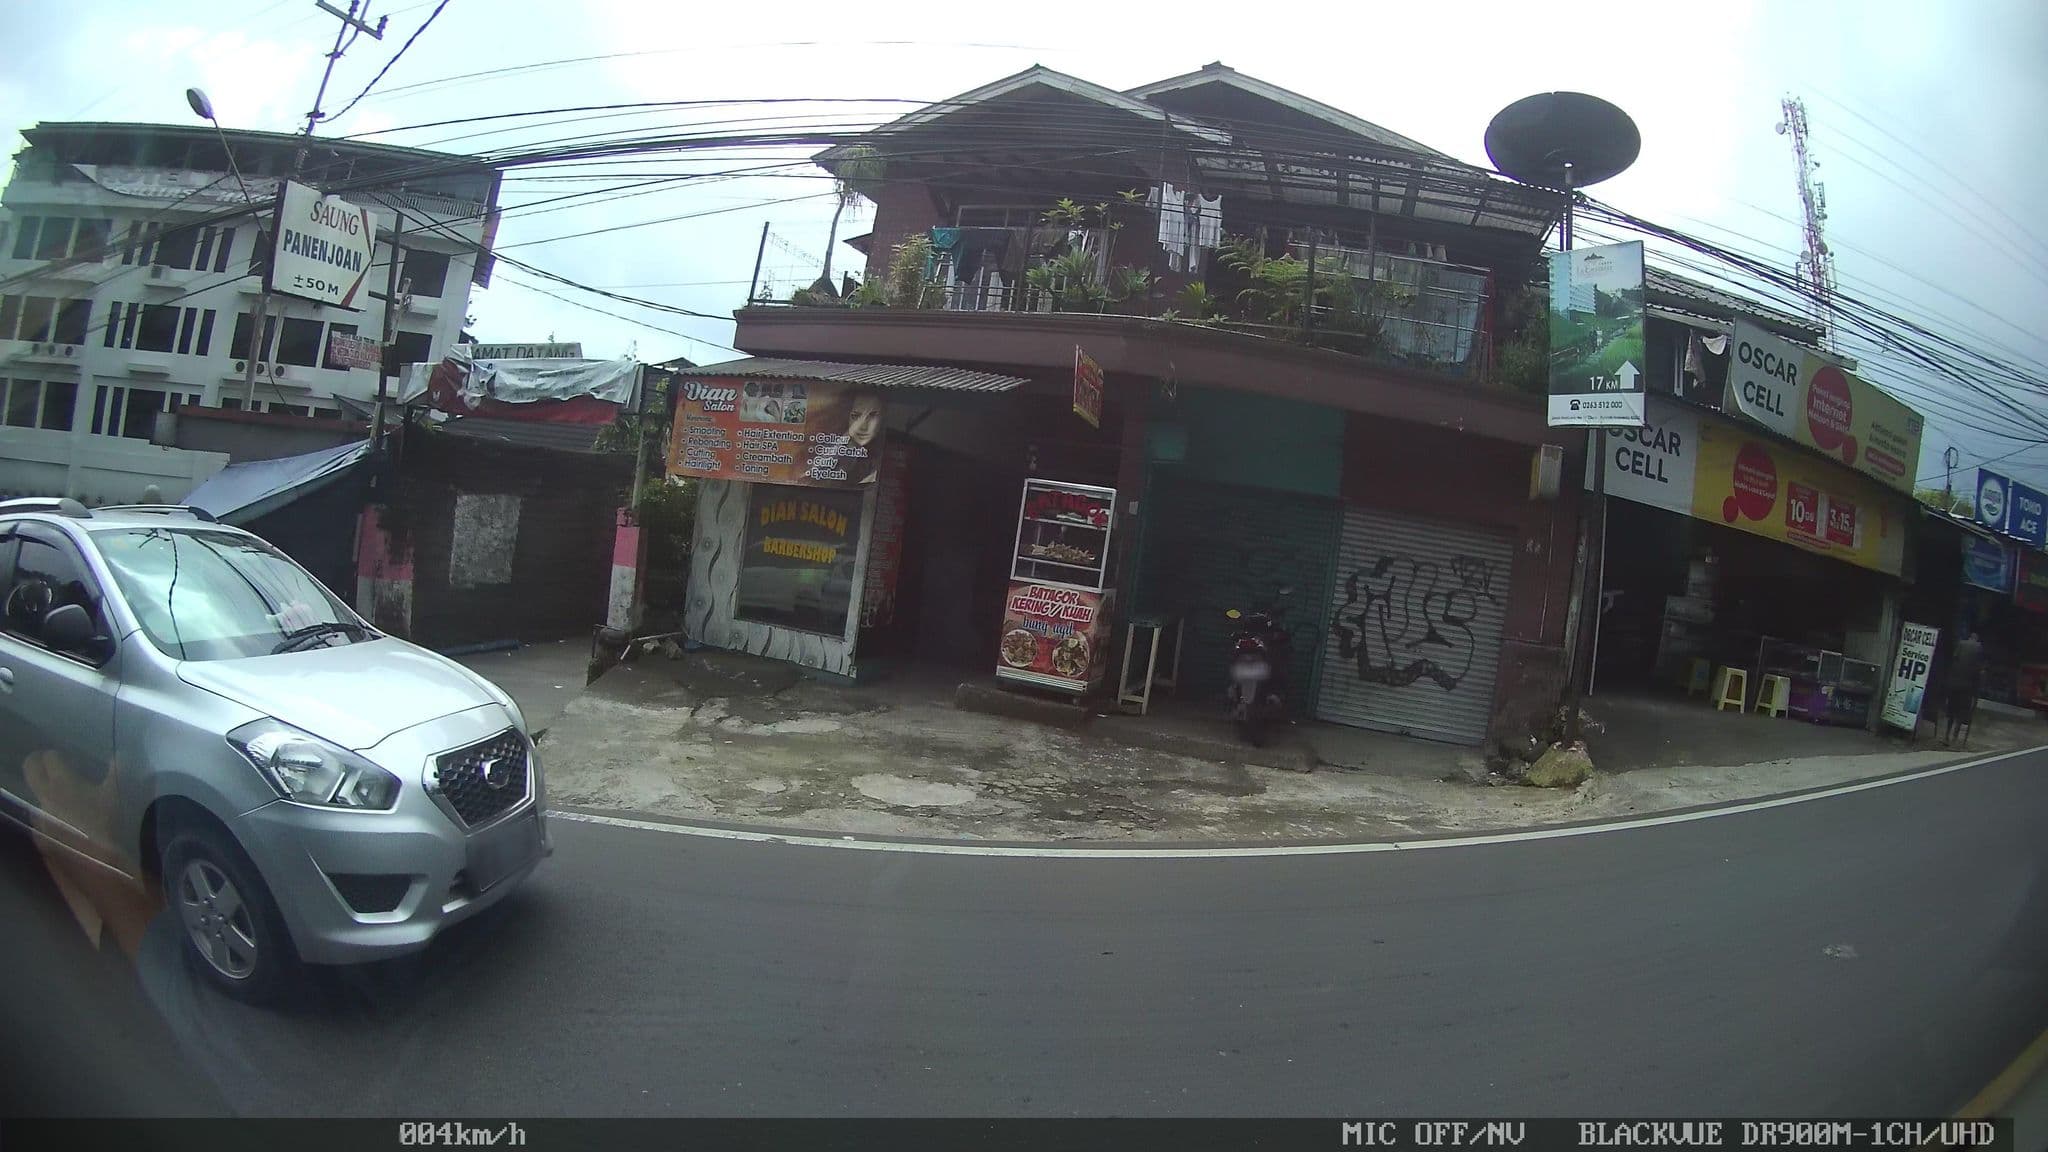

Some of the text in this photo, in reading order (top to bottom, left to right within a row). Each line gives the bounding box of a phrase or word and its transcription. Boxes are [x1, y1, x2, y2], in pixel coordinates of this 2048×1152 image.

[310, 200, 359, 235] SAUNG
[283, 229, 362, 272] PANENJOAN
[472, 346, 512, 359] AMAT
[1738, 341, 1797, 386] OSCAR
[683, 382, 738, 402] Dian
[1590, 376, 1618, 391] 17 KM
[703, 401, 736, 412] Salon
[1598, 401, 1609, 410] 512
[1743, 380, 1784, 417] CELL
[744, 429, 804, 441] Hair Extention
[689, 438, 731, 450] Rebonding
[743, 440, 778, 451] Hair SPA
[743, 452, 793, 464] Creambath
[814, 458, 838, 469] Curly
[1615, 446, 1669, 484] CELL
[811, 468, 847, 480] Eyelash
[761, 501, 847, 536] DIAN SALON
[1790, 499, 1805, 523] 10
[2020, 516, 2038, 534] ACE
[763, 537, 837, 564] BARBERSHOP
[1028, 585, 1079, 605] BATAGOR
[1061, 605, 1092, 622] KUAH
[1902, 647, 1929, 662] Service
[1898, 657, 1926, 681] HP
